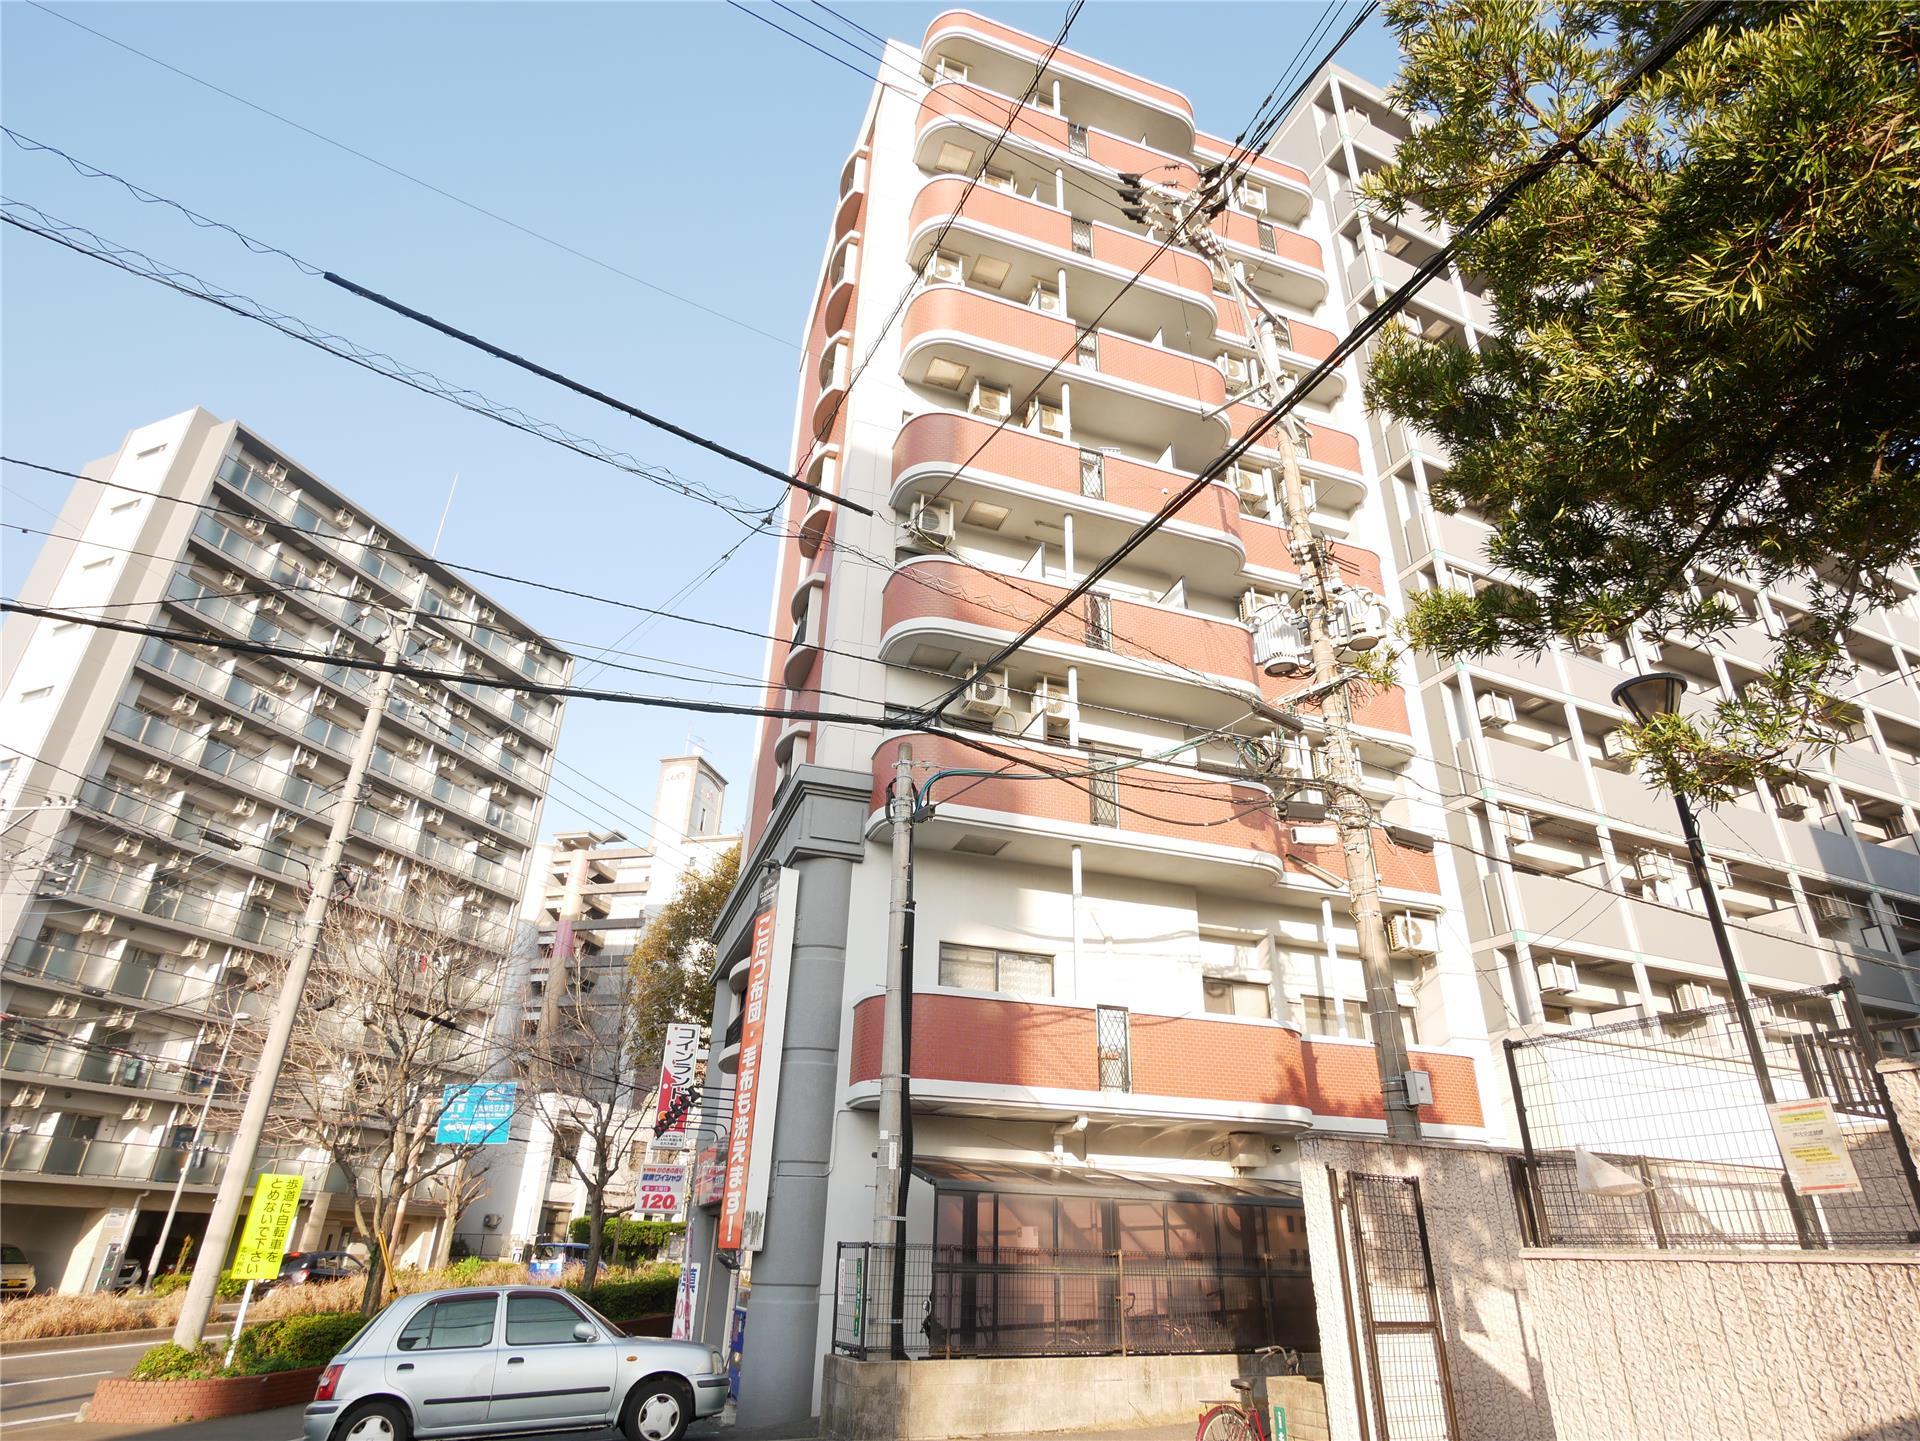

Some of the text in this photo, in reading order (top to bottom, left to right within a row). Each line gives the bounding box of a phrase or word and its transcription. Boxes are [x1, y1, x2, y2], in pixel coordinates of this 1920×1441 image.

[246, 1178, 282, 1275] とめないで下さい
[266, 1179, 299, 1263] 歩道に自転車を
